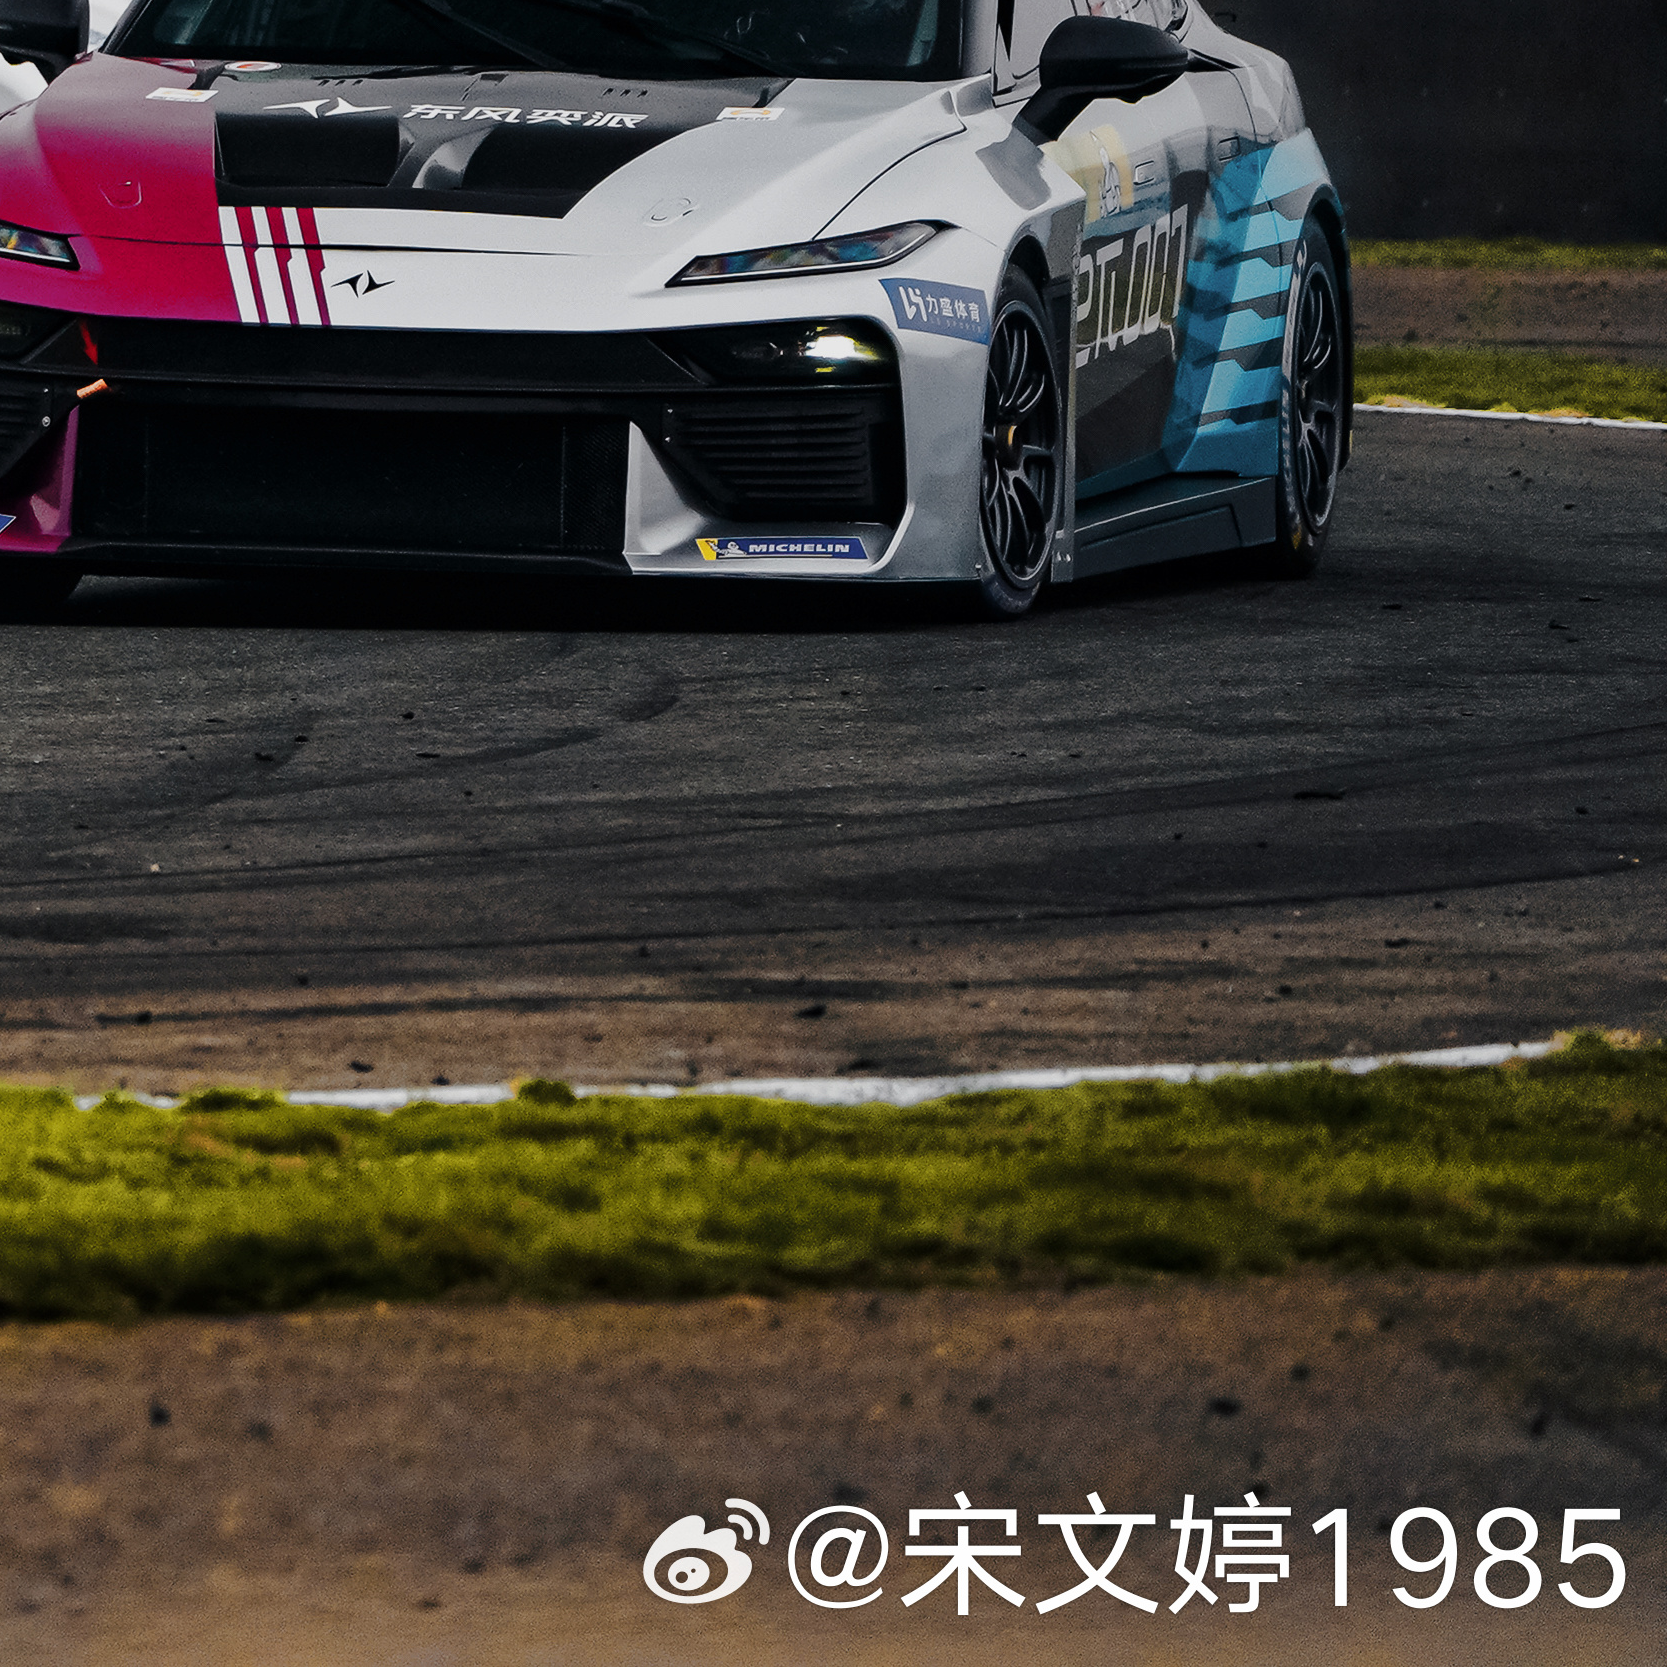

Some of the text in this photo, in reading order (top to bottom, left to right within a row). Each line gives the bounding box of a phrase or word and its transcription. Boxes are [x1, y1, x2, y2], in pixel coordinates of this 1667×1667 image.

[402, 103, 650, 130] 东风奕派
[925, 293, 981, 323] 力盛体育
[748, 543, 850, 553] MICHELIN
